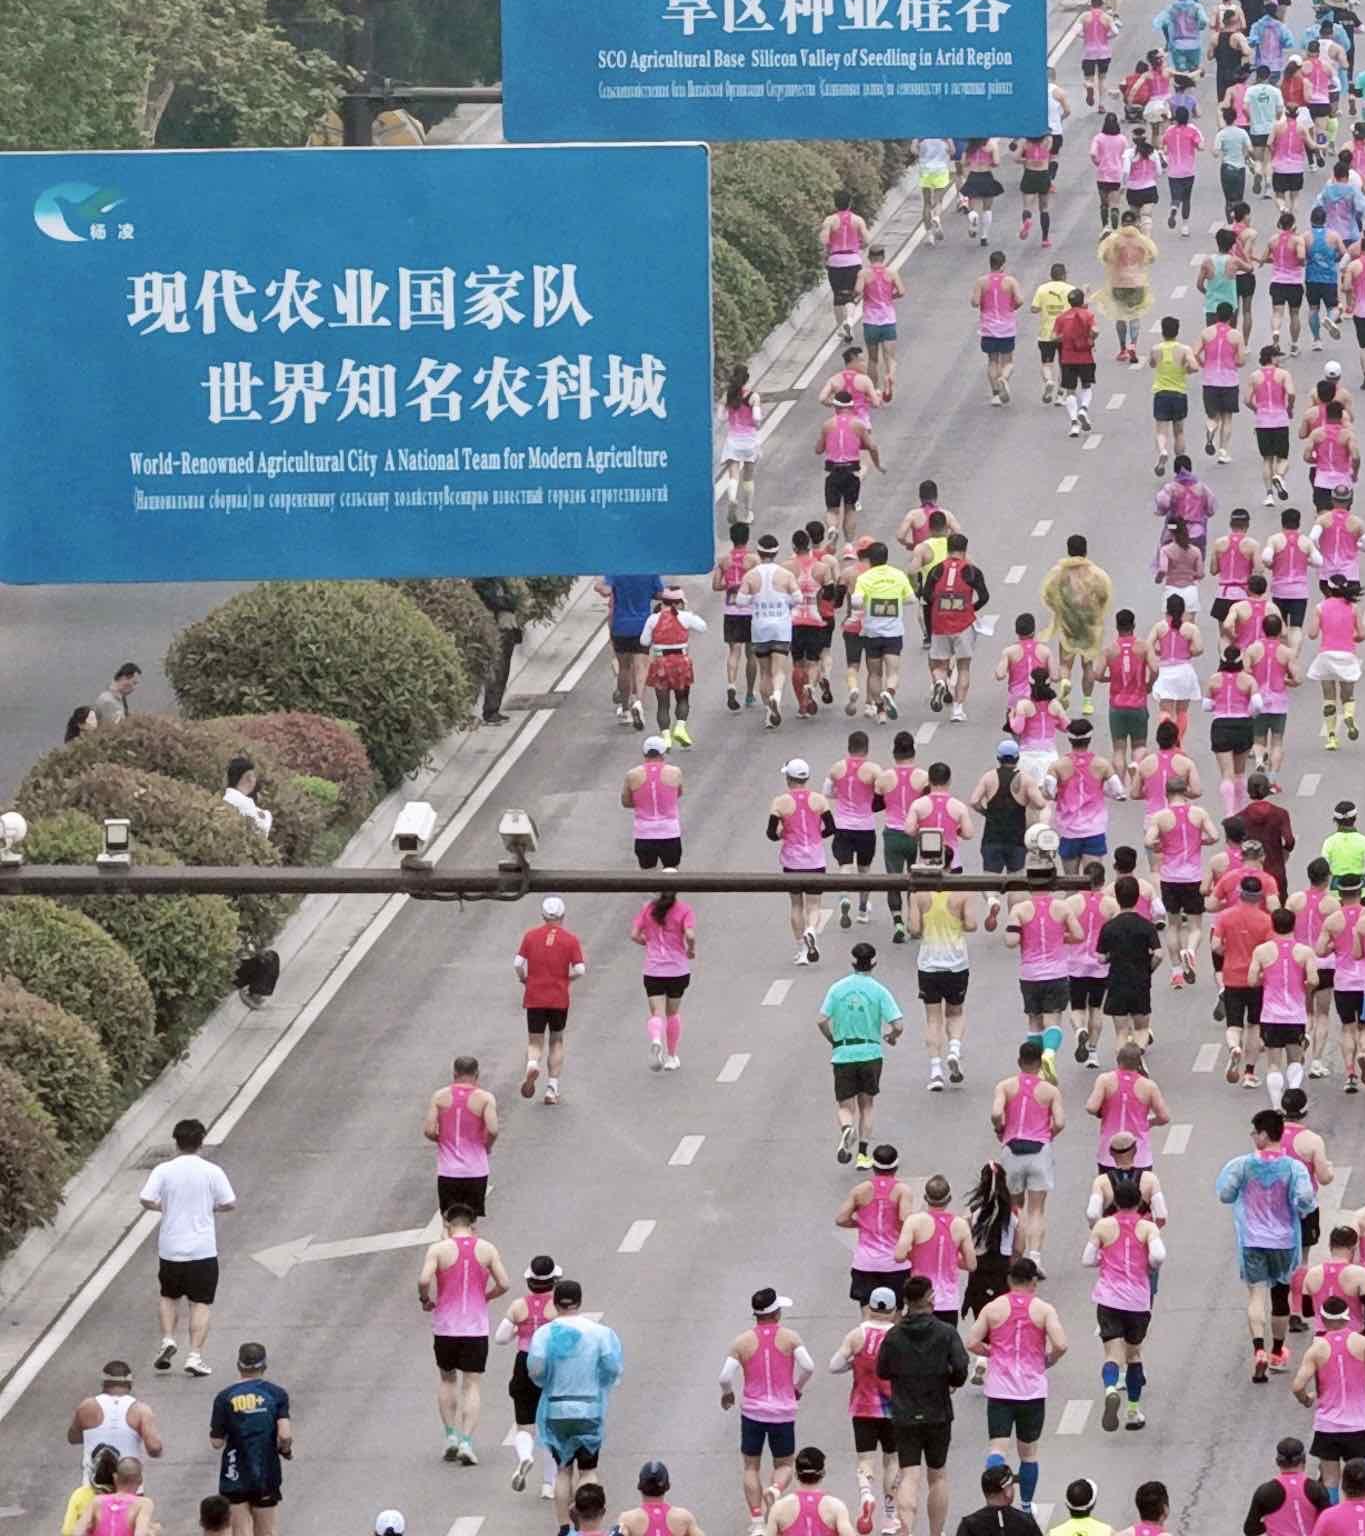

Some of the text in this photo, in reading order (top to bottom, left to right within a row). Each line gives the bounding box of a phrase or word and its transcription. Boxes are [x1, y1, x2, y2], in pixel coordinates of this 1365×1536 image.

[598, 47, 1013, 72] SCO Agricultural Base Silicon Valley of Seedling in Arid Region
[126, 264, 593, 336] 现代农业国家队
[201, 353, 667, 424] 世界知名农科城
[130, 445, 668, 478] World-Renowned Agricultural City A National Team for Modern Agriculture
